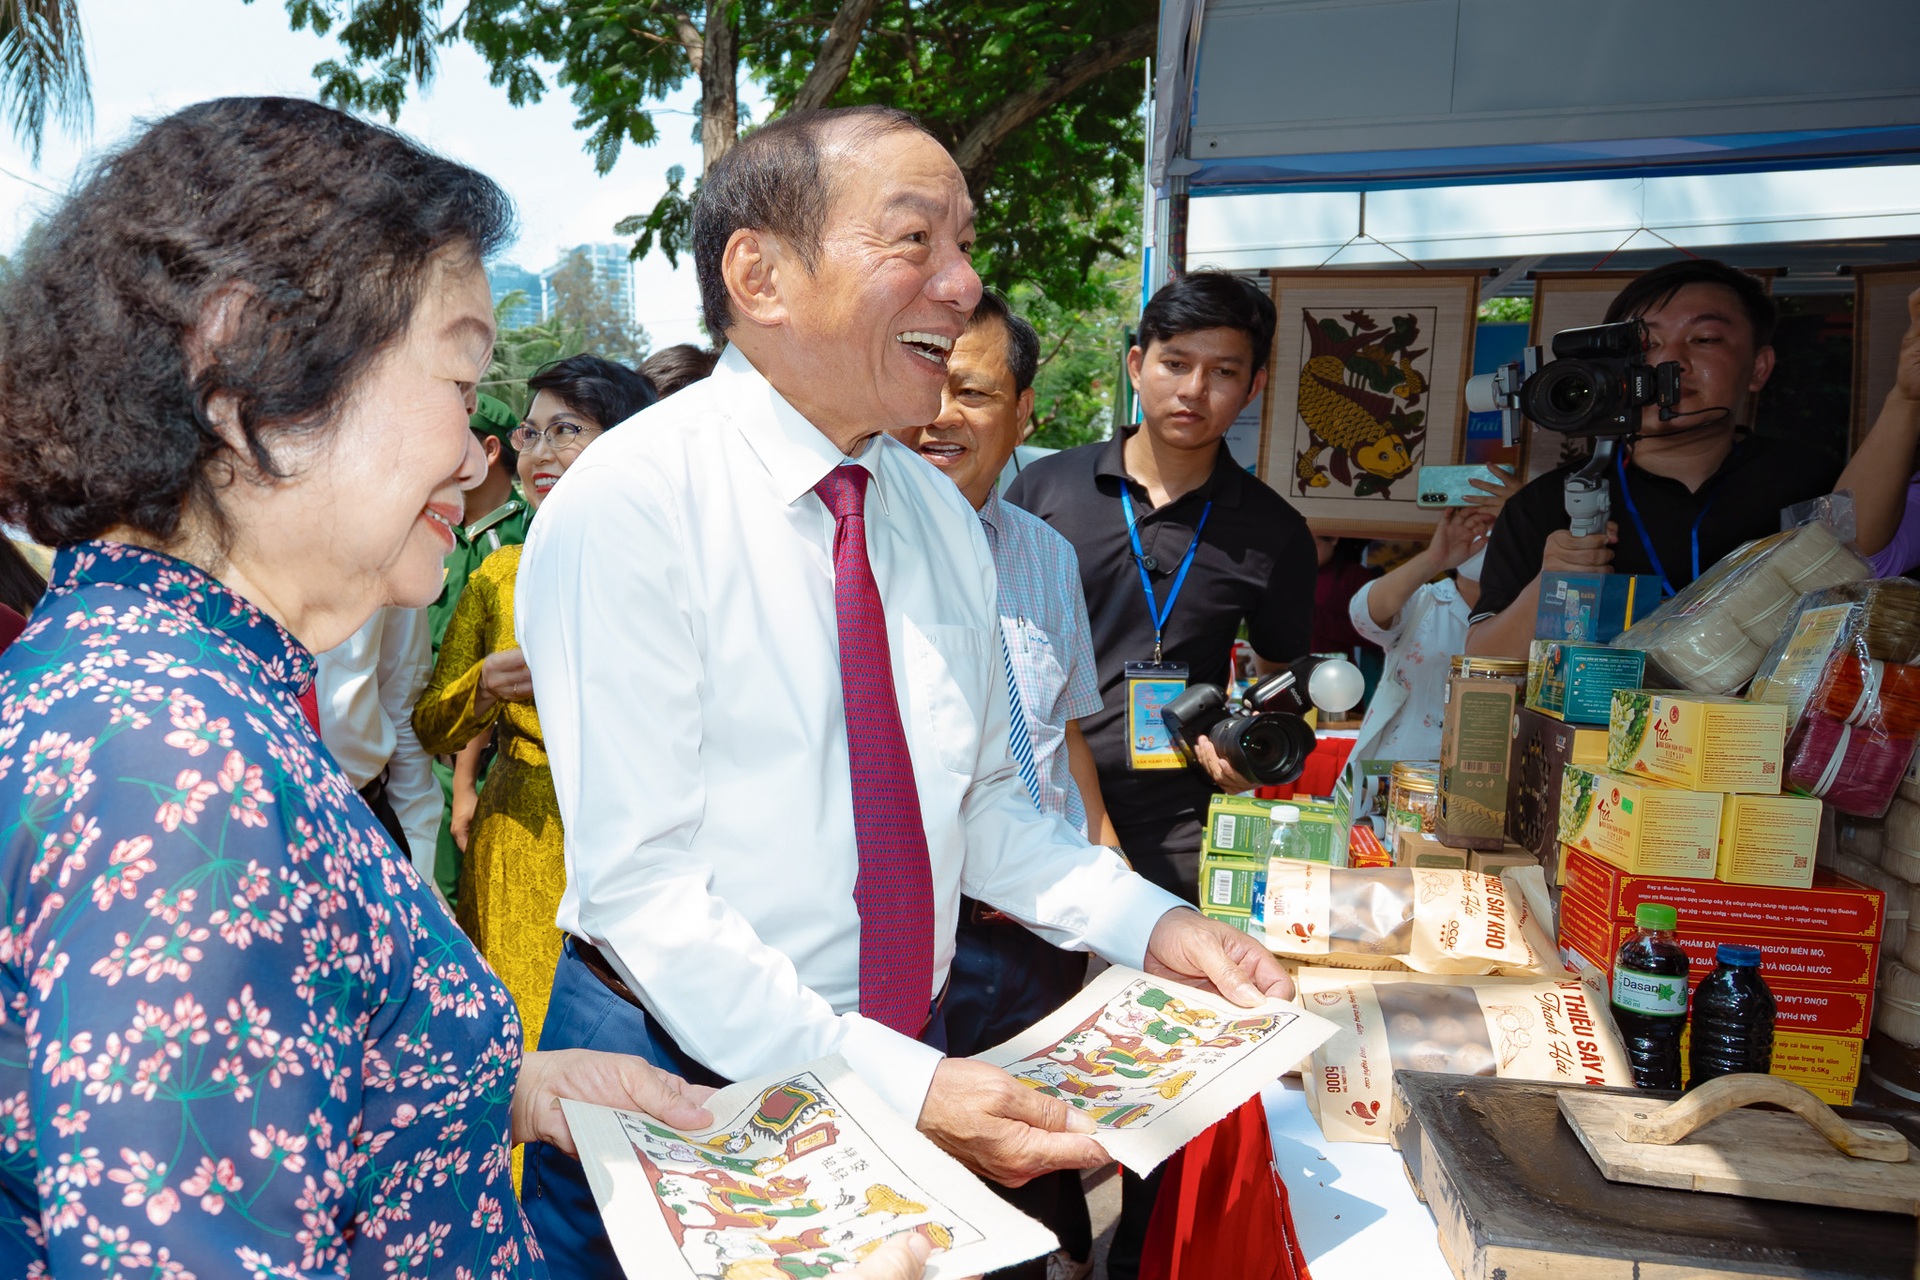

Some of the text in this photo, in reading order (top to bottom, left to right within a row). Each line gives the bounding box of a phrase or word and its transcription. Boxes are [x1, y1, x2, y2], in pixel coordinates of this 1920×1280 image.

[1763, 902, 1776, 910] được
[1788, 904, 1809, 912] Nguyên
[1814, 906, 1826, 914] khác
[1828, 906, 1838, 914] liệu
[1766, 913, 1780, 921] Vừng
[1449, 920, 1460, 951] OCOP
[1486, 920, 1508, 950] KHÔ
[1762, 944, 1788, 954] NGƯỜI
[1696, 956, 1714, 966] QUÀ
[1766, 960, 1778, 970] VÀ
[1779, 962, 1805, 972] NGOÀI
[1806, 963, 1832, 974] NƯỚC
[1623, 977, 1661, 993] Dasani
[1785, 994, 1802, 1004] LÀM
[1804, 996, 1828, 1006] DÙNG
[1534, 992, 1566, 1036] Thanh
[1564, 994, 1596, 1038] THIỀU
[1812, 1044, 1824, 1052] vàng
[1548, 1040, 1574, 1076] Hải
[1576, 1040, 1606, 1074] SẤY
[1801, 1055, 1815, 1064] trong
[1811, 1066, 1830, 1074] 0,5Kg
[1324, 1066, 1341, 1093] 500G
